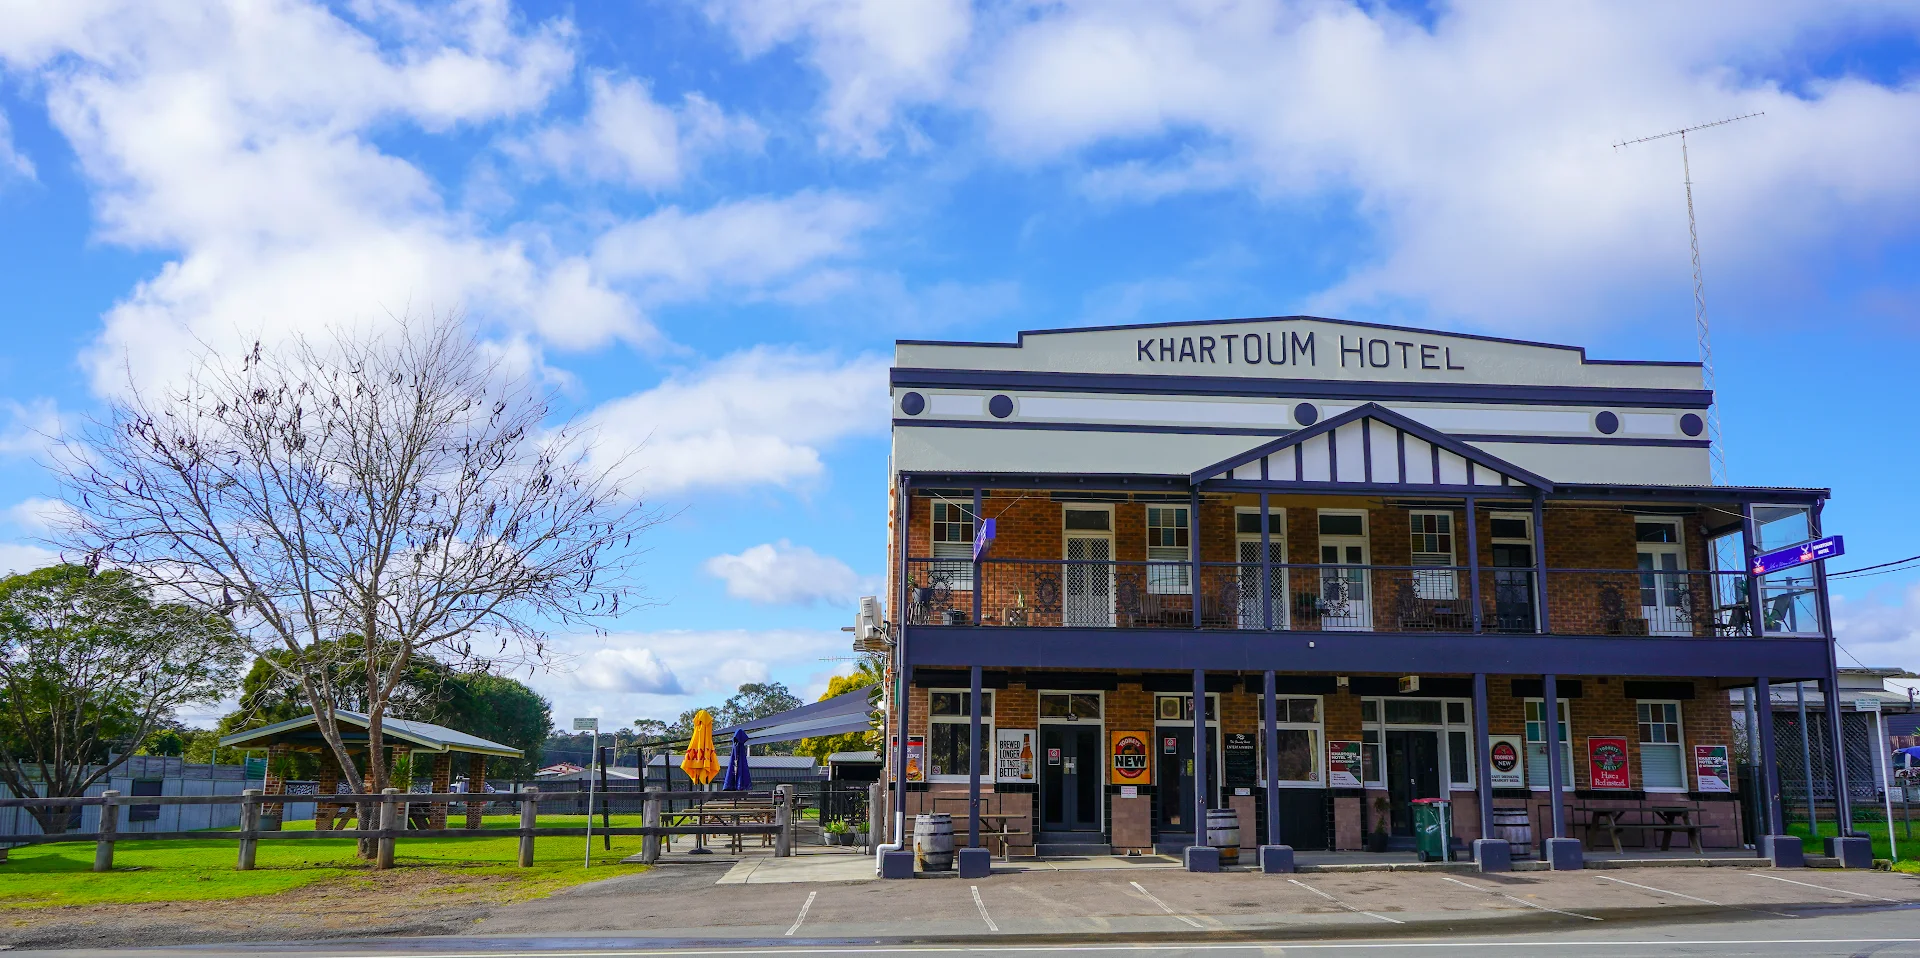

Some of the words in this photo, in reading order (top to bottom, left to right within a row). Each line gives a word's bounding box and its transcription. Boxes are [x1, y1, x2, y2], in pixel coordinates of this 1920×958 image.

[1137, 331, 1316, 367] KHARTOUM
[1339, 334, 1465, 370] HOTEL
[1000, 741, 1020, 749] BREWED
[1118, 737, 1142, 747] TOOHEYS
[1000, 750, 1020, 759] LONGER
[1115, 755, 1147, 767] NEW
[1000, 768, 1020, 777] BETTER
[1601, 771, 1615, 779] Have
[1595, 778, 1606, 786] Red
